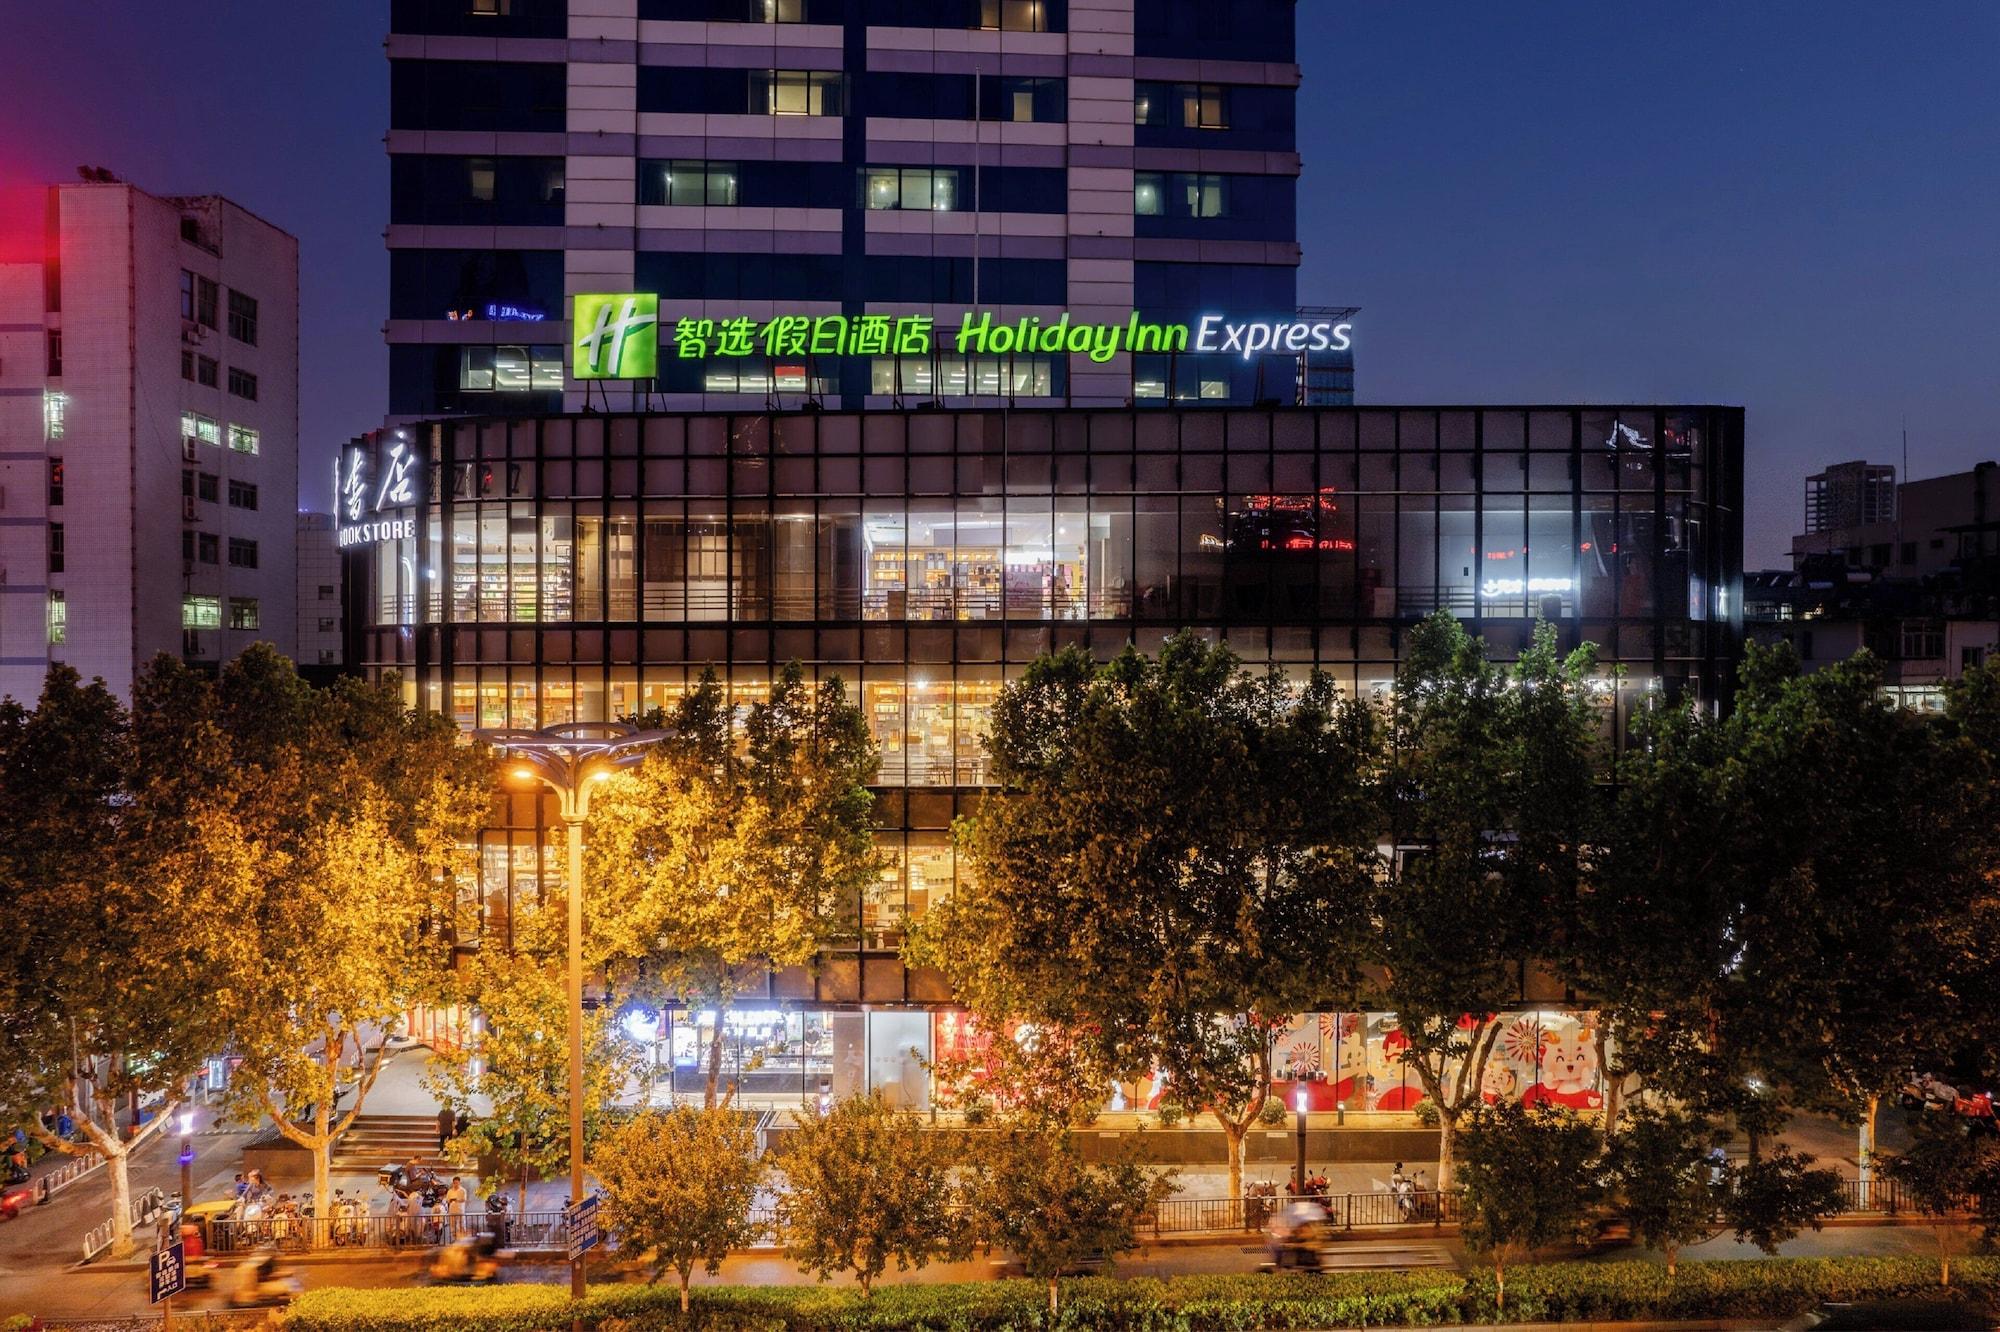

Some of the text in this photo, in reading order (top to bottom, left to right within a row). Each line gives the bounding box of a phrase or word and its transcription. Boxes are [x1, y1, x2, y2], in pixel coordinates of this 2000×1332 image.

[673, 313, 934, 359] 智选假日酒店
[955, 310, 1352, 363] Holiday Inn Express
[159, 1250, 170, 1271] P
